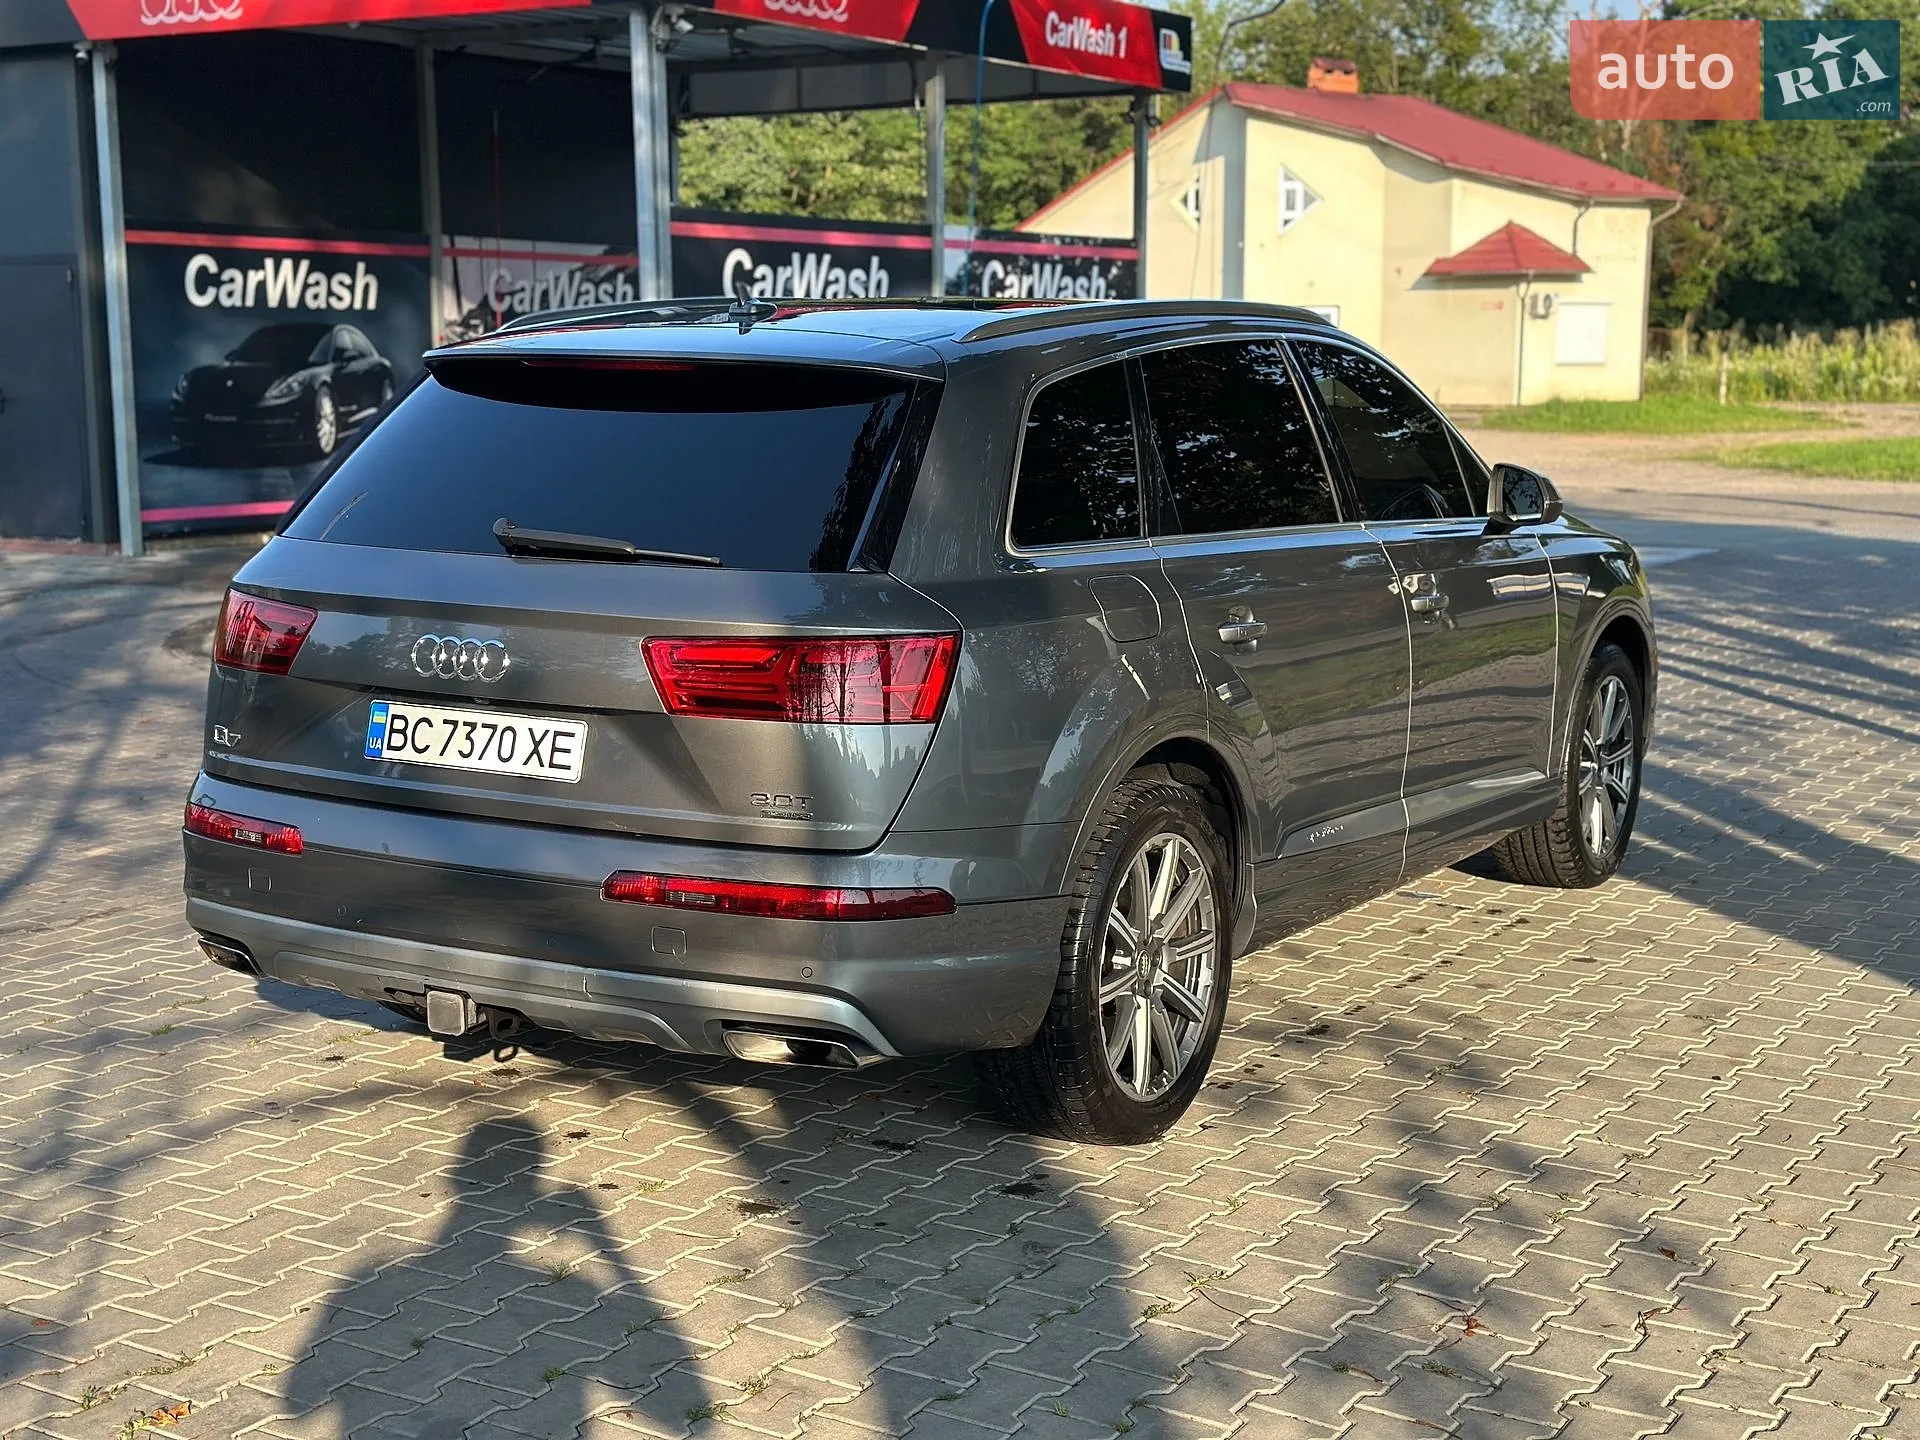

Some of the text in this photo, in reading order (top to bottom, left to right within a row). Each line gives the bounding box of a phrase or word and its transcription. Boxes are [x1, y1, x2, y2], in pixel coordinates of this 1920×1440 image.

[1045, 11, 1128, 59] CarWash 1
[184, 253, 379, 311] CarWash
[488, 267, 634, 313] CarWash
[723, 248, 890, 299] CarWash
[981, 259, 1107, 300] CarWash
[369, 737, 382, 749] UA
[386, 713, 576, 770] BC 7370 XE
